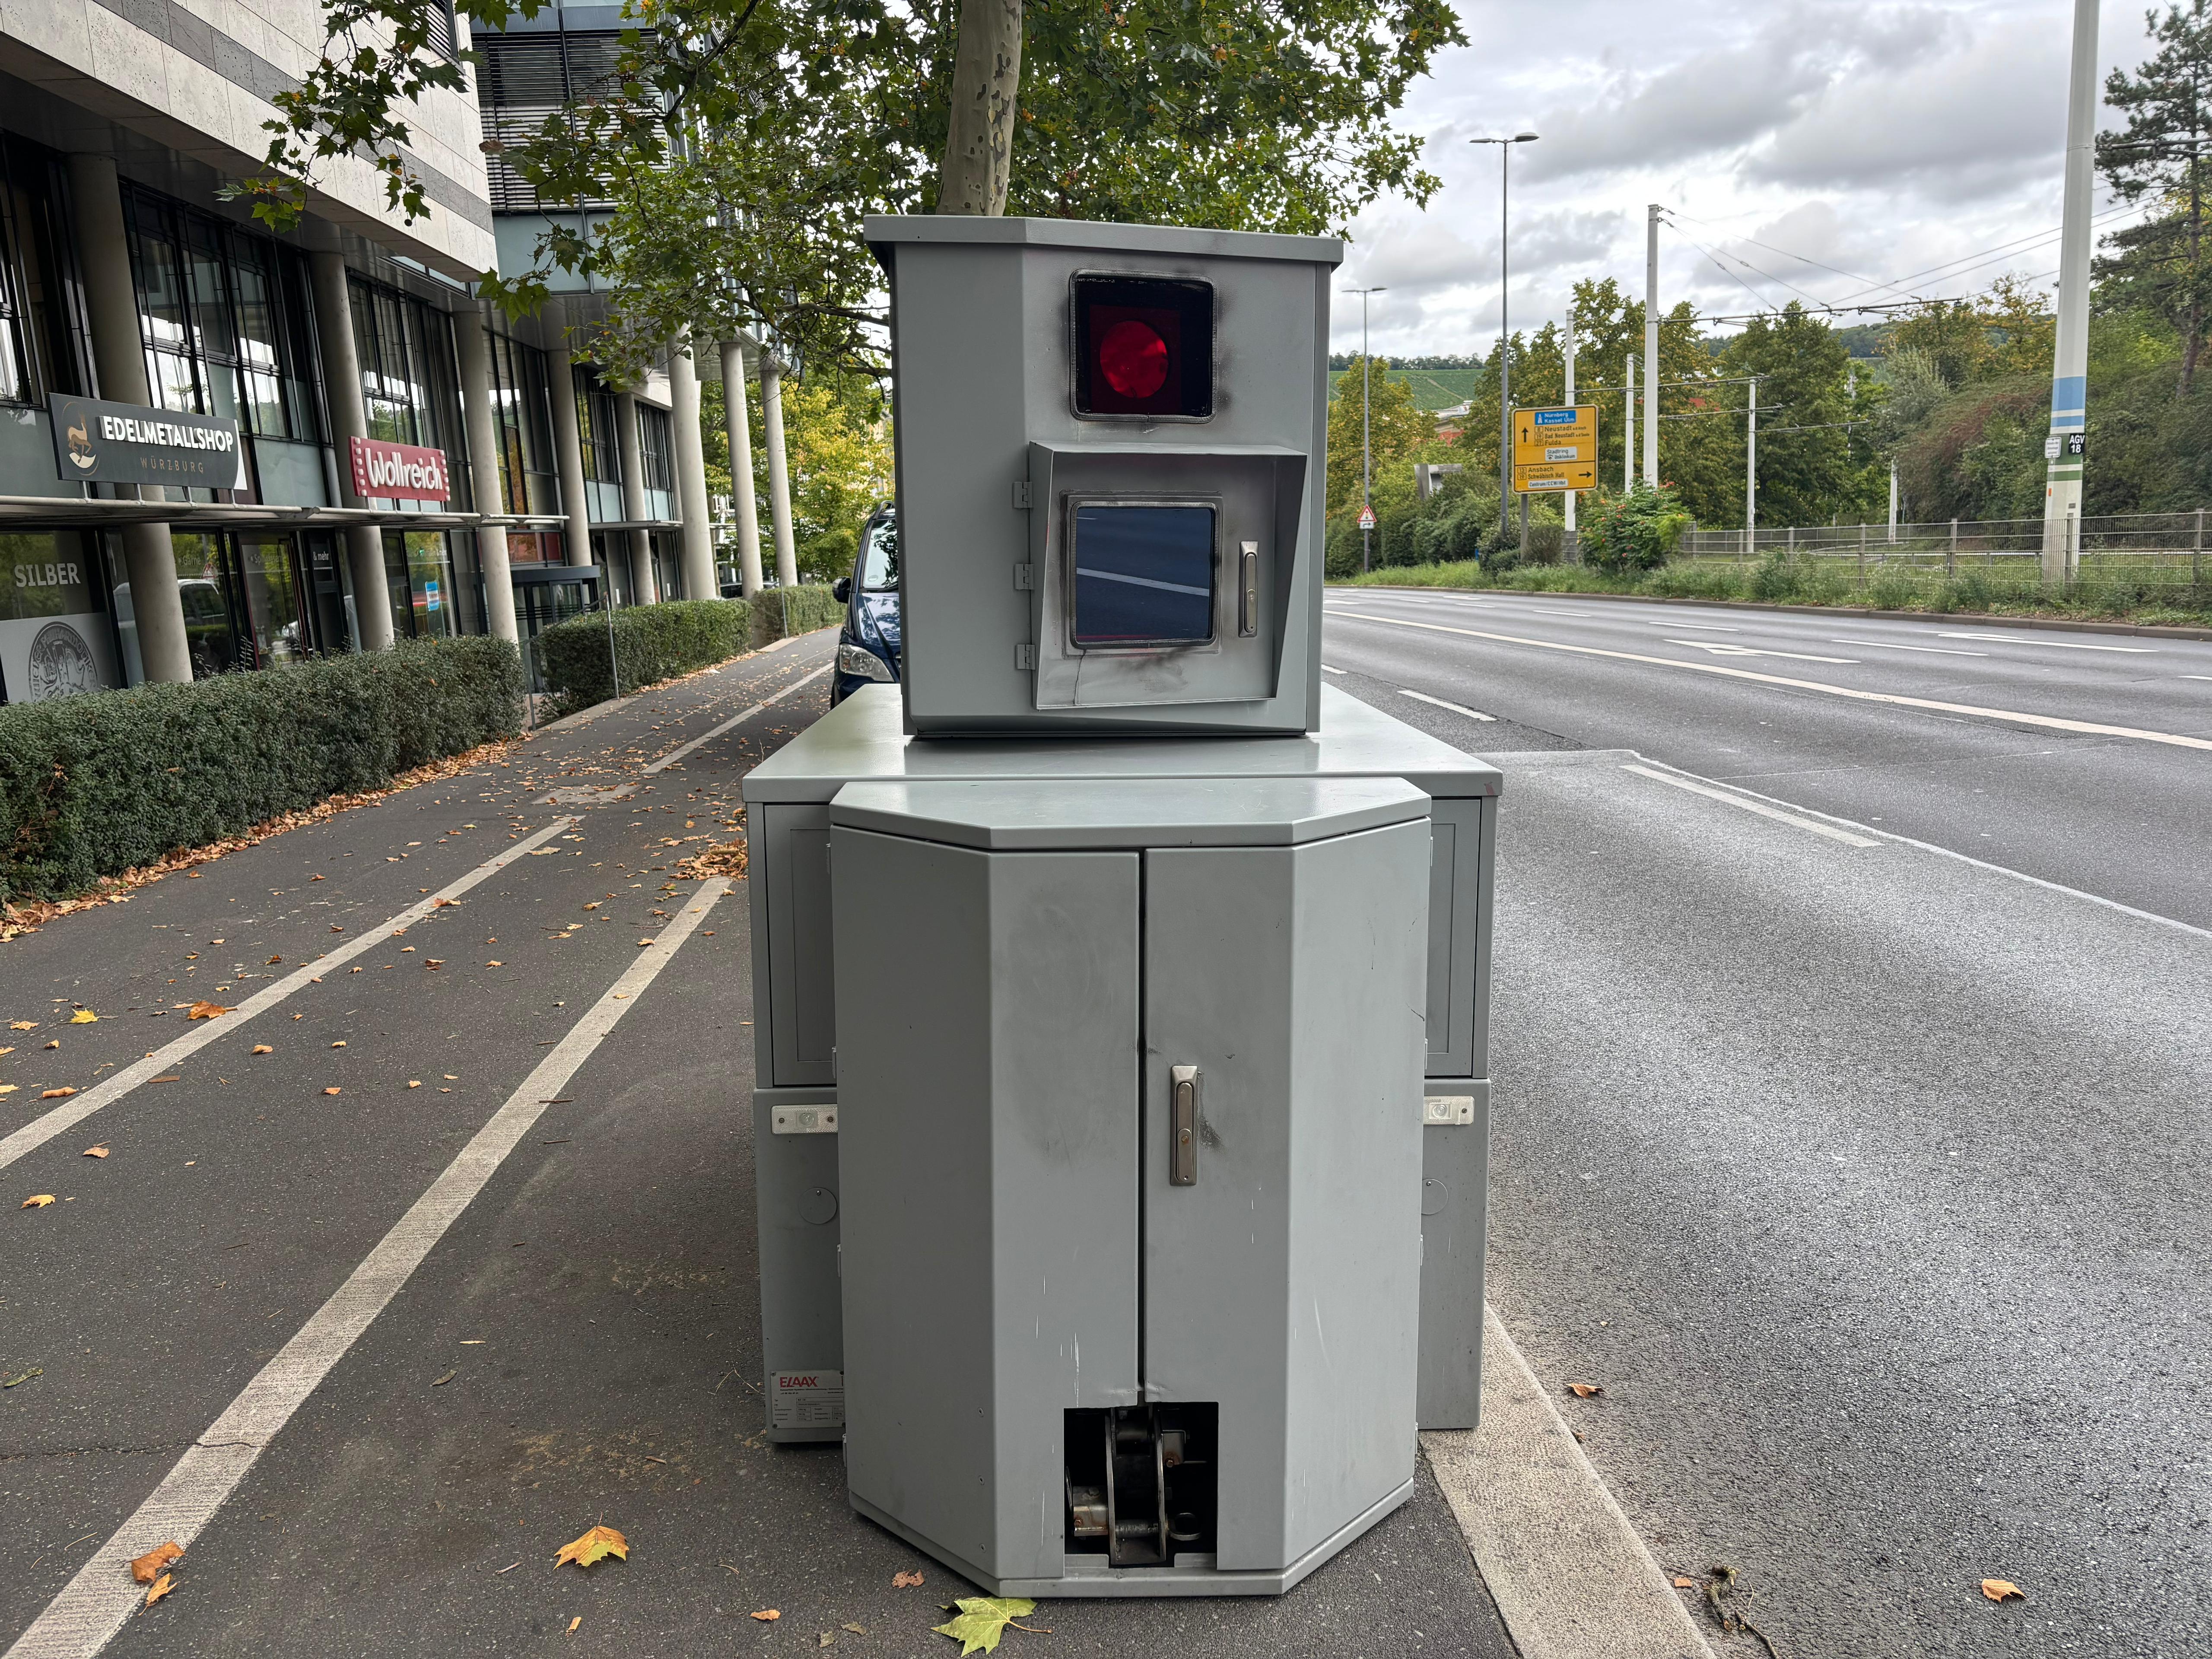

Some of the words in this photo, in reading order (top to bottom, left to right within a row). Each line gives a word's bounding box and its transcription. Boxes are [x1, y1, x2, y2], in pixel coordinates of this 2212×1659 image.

[102, 416, 234, 452] EDELMETALLSHOP
[2069, 435, 2085, 444] AGV
[2071, 444, 2081, 453] 18
[140, 455, 203, 474] WÜRZBURG
[365, 448, 443, 490] Wollreich
[318, 550, 329, 560] mehr
[14, 563, 81, 588] SILBER
